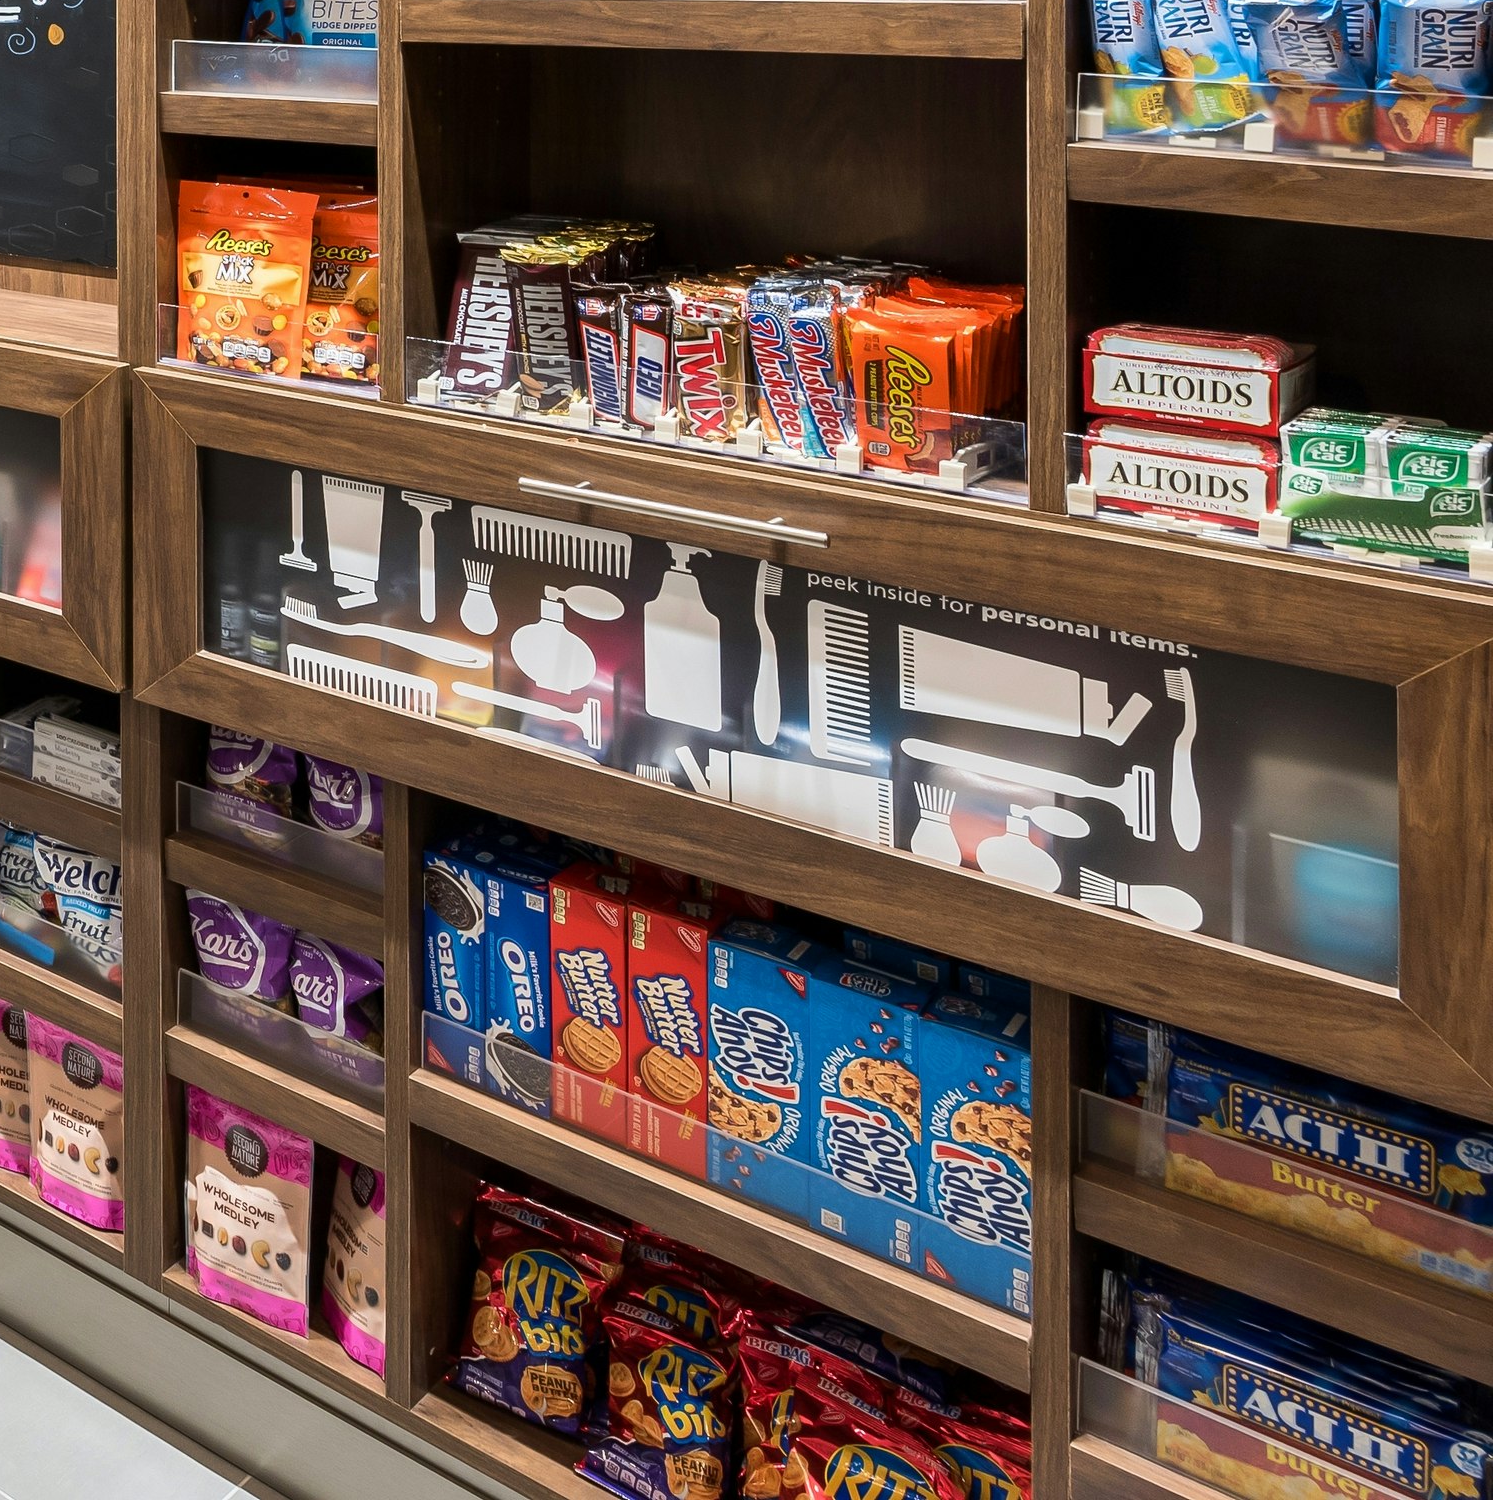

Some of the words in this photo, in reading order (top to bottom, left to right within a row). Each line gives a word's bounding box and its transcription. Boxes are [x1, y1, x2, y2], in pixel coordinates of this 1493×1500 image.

[313, 1, 378, 19] BITES
[343, 22, 376, 30] DIPPED
[1420, 8, 1450, 70] GRAIN
[1445, 9, 1478, 69] NUTRI
[206, 229, 273, 256] Reese's
[461, 287, 469, 303] MILK
[453, 304, 468, 345] CHOCOLATE
[456, 256, 513, 390] HERSHEY'S
[585, 327, 621, 417] INCOMPLETE
[1110, 369, 1253, 408] ALTOIDS
[886, 345, 932, 449] Reese's
[1126, 397, 1235, 417] PEPPERMINT
[1310, 450, 1347, 463] tac
[1319, 441, 1349, 454] tic
[1418, 455, 1450, 469] tic
[1107, 461, 1250, 503] ALTOIDS
[1410, 465, 1448, 478] tac
[1123, 489, 1231, 511] PEPPERMINT
[807, 572, 860, 594] peek
[867, 580, 931, 608] inside
[939, 594, 973, 615] for
[981, 605, 1099, 640] personal
[1109, 629, 1198, 659] items.
[87, 903, 107, 916] FRUIT
[438, 931, 469, 1021] OREO
[502, 941, 535, 1032] OREO
[558, 952, 601, 1026] Butter
[580, 951, 617, 1025] Nutter
[742, 1009, 793, 1084] Chips
[819, 1045, 856, 1093] ORIGINAL
[44, 1095, 105, 1130] WHOLESOME
[52, 1113, 92, 1138] MEDLEY
[231, 1144, 261, 1168] NATURE
[233, 1134, 260, 1154] SECOND
[831, 1115, 882, 1193] Chips
[1249, 1104, 1350, 1156] ACT
[1354, 1136, 1410, 1179] II
[203, 1182, 275, 1222] WHOLESOME
[1270, 1160, 1381, 1214] Butter
[214, 1201, 260, 1230] MEDLEY
[505, 1253, 590, 1327] RITZ
[521, 1321, 583, 1354] bits
[530, 1372, 578, 1391] PEANUT
[532, 1384, 580, 1400] BUTTER
